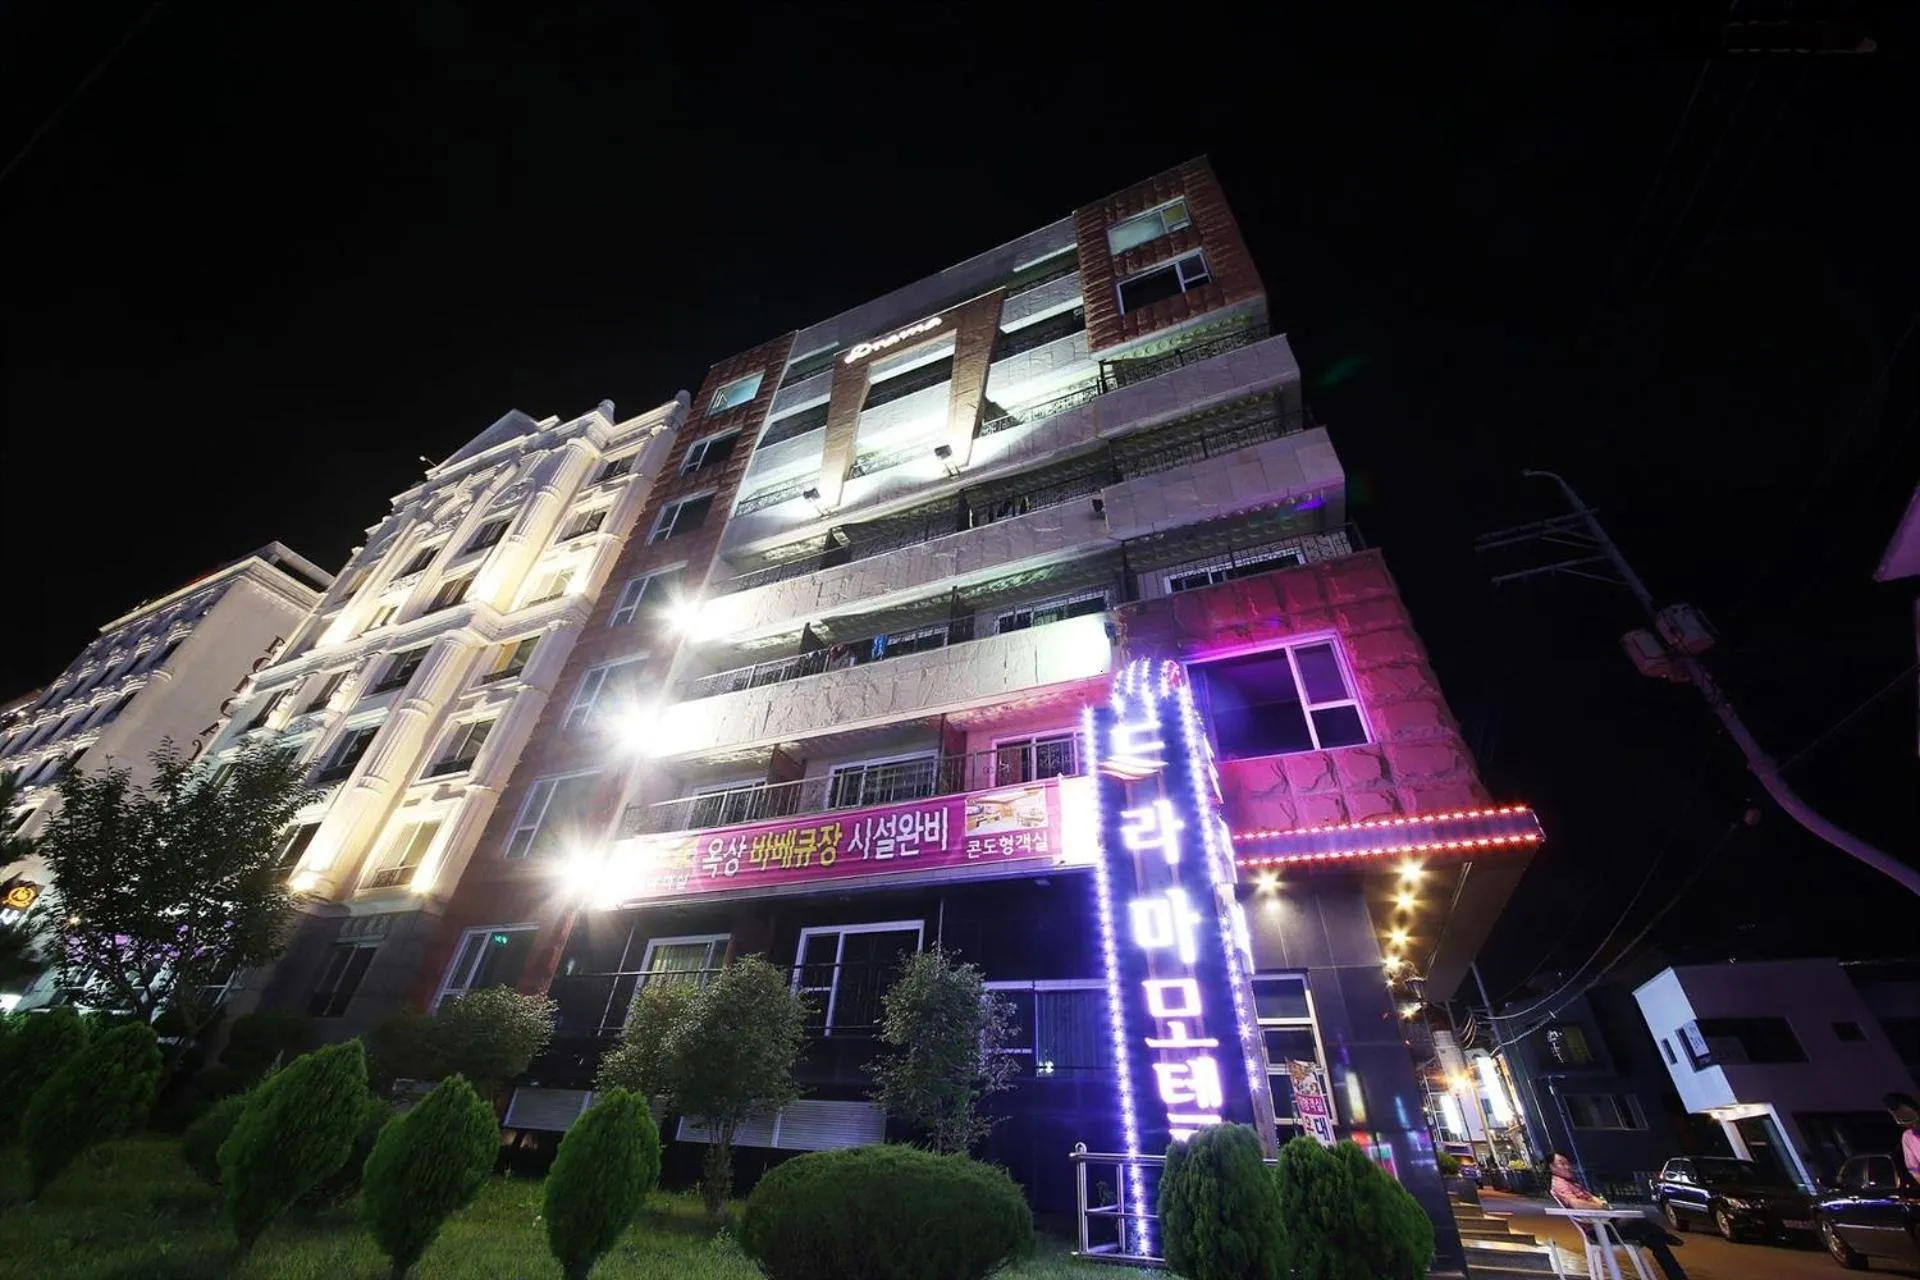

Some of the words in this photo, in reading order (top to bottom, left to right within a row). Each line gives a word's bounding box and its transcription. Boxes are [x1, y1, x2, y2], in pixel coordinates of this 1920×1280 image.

[702, 835, 747, 878] 옥상
[748, 822, 843, 871] 바베큐장
[847, 806, 948, 860] 시설완비
[966, 830, 1048, 859] 콘도형객실
